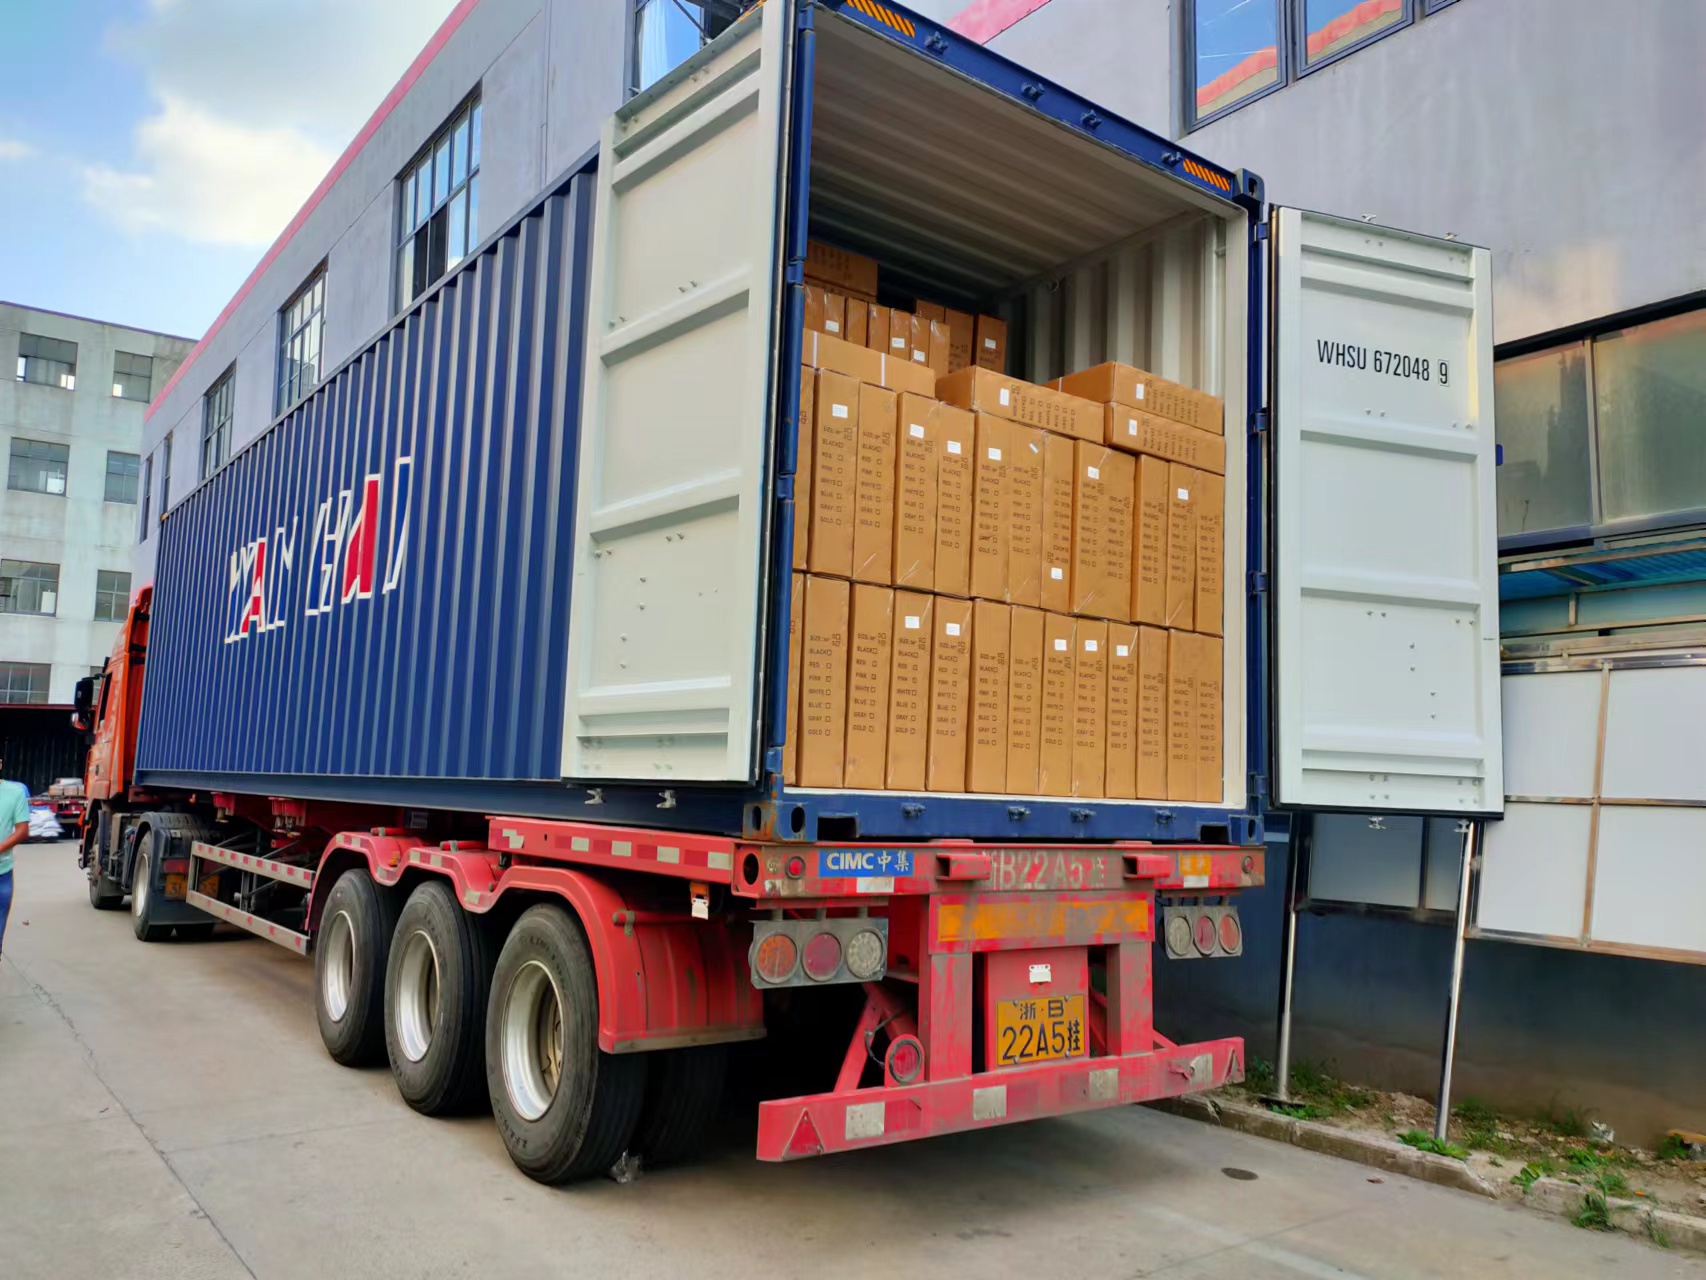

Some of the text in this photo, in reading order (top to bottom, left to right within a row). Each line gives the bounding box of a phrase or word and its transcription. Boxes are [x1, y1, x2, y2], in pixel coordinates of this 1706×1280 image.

[1317, 339, 1448, 384] WHSU 672048 9
[224, 456, 412, 644] WAN HAI
[826, 850, 910, 872] CIMC 中集
[1002, 1017, 1080, 1061] 22A5挂
